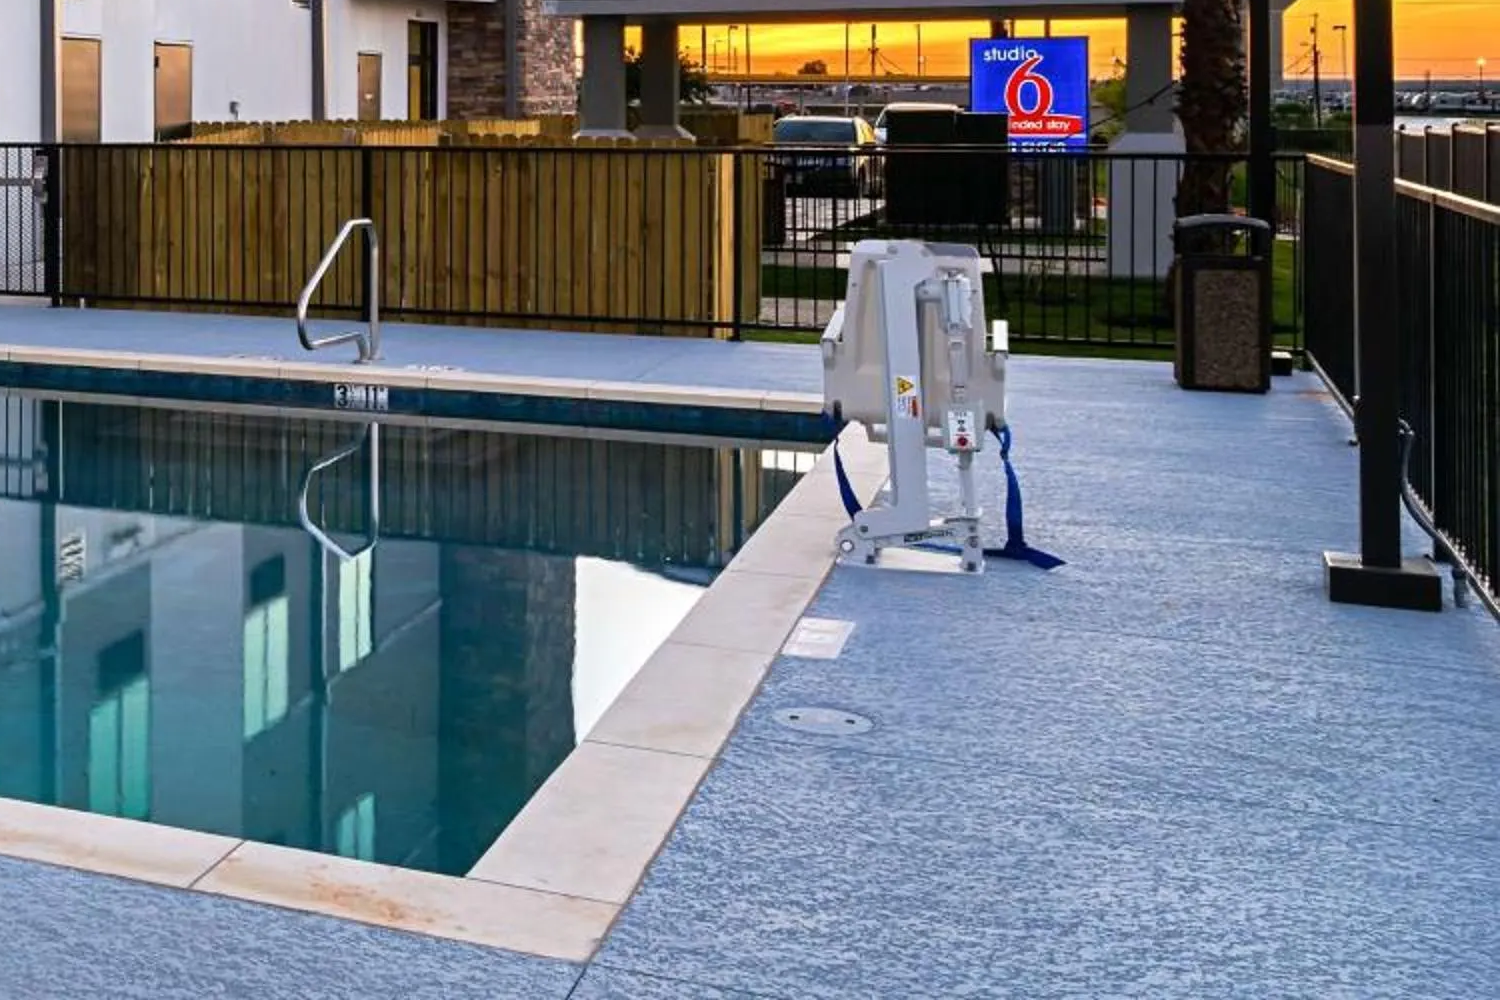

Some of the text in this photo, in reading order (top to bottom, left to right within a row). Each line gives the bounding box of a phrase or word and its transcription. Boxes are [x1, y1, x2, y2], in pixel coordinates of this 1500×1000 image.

[983, 46, 1038, 62] studio
[1004, 55, 1053, 116] 6
[1047, 120, 1071, 131] stay
